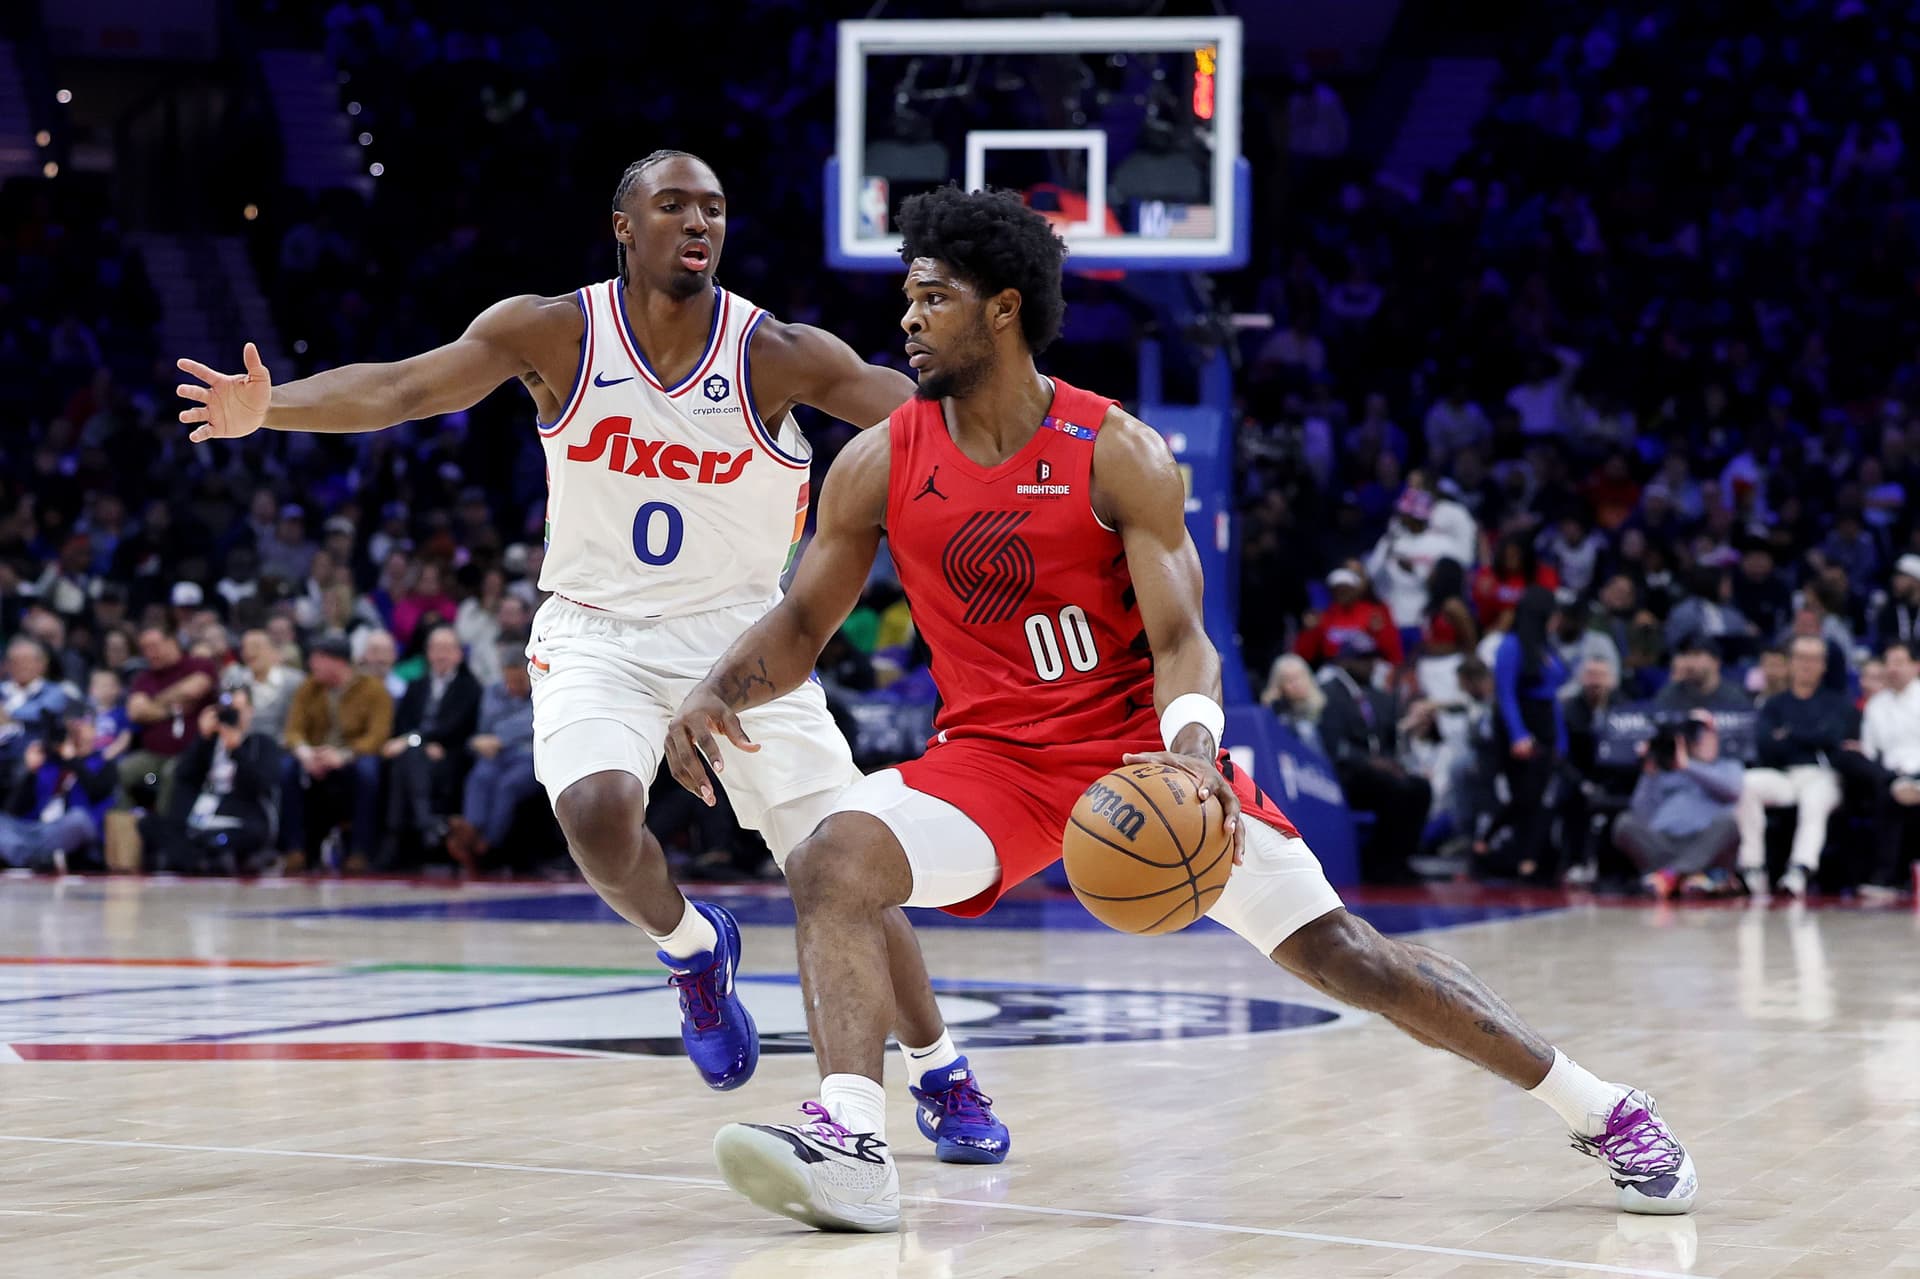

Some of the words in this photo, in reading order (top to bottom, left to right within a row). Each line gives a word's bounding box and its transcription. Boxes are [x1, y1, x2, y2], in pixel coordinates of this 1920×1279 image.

[692, 406, 741, 415] crypto.com
[1063, 422, 1079, 436] 32
[567, 416, 753, 484] Sixers
[1016, 484, 1070, 495] BRIGHTSIDE
[632, 501, 684, 566] 0
[1024, 604, 1099, 682] 00
[1085, 782, 1145, 842] Wilso
